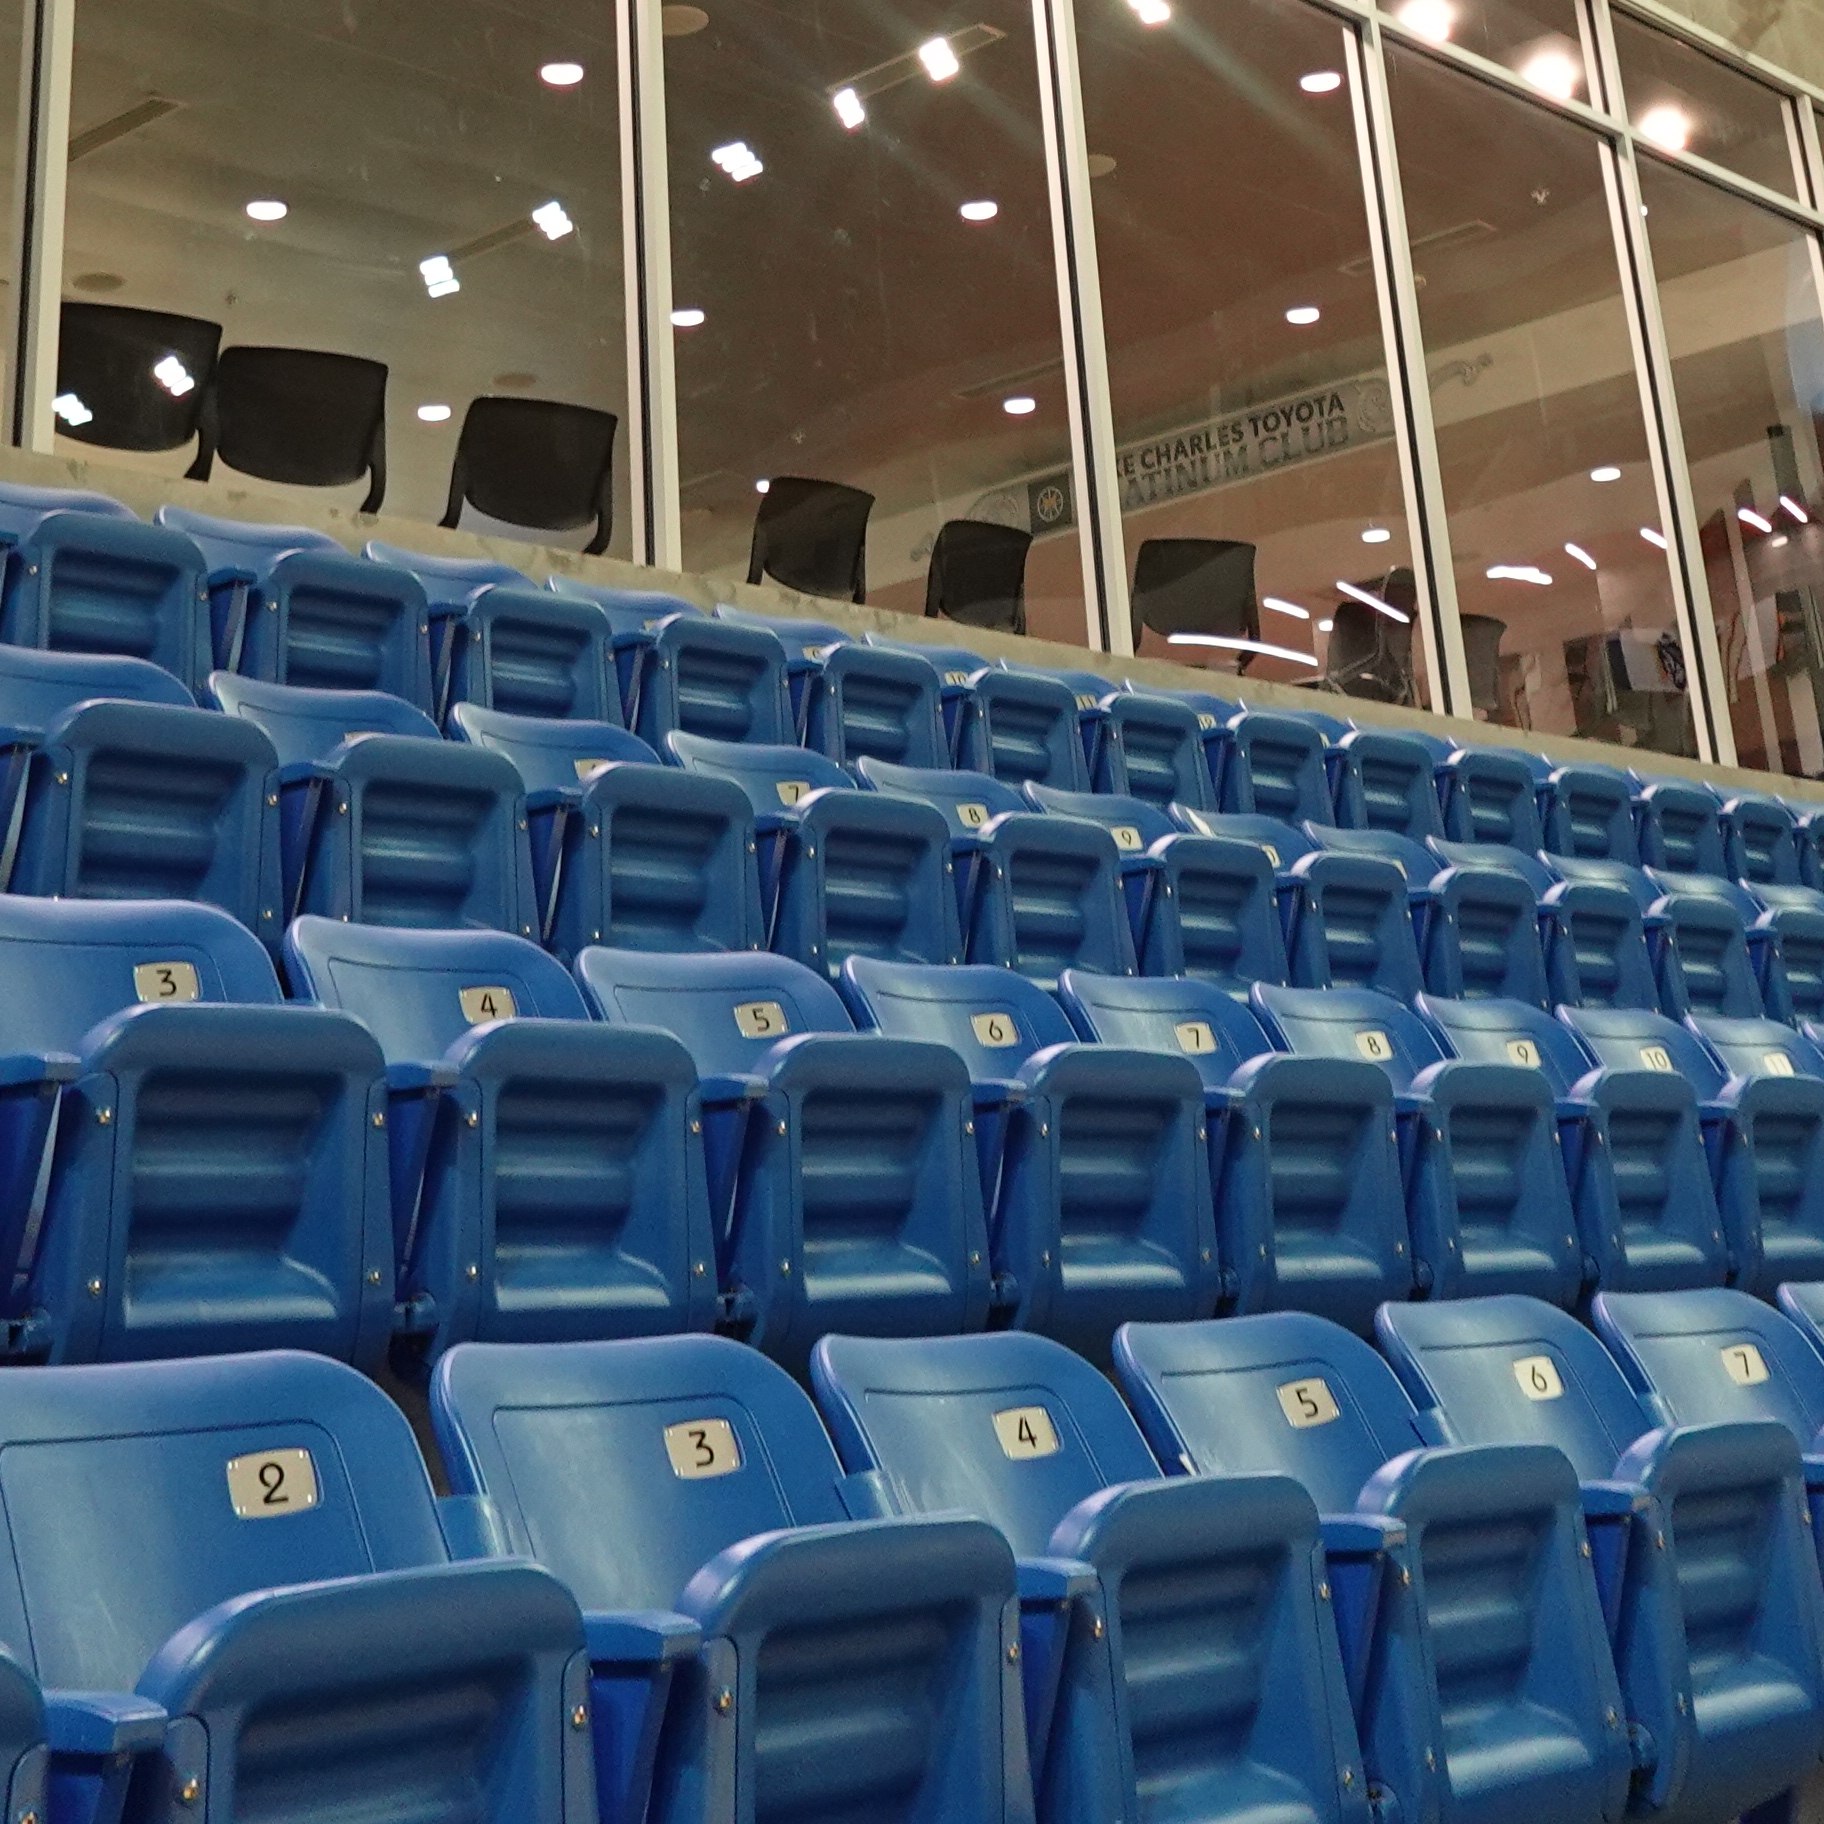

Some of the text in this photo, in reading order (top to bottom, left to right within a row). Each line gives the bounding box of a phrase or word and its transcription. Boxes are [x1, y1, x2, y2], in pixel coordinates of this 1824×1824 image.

[1140, 420, 1244, 470] CHARLES
[1248, 391, 1346, 439] TOYOTA
[788, 785, 799, 803] 7
[968, 806, 981, 824] 8
[1121, 829, 1132, 846] 9
[156, 969, 177, 996] 3
[480, 992, 498, 1017] 4
[752, 1007, 770, 1032] 5
[988, 1018, 1004, 1042] 6
[1188, 1027, 1200, 1049] 7
[1367, 1035, 1382, 1056] 8
[1516, 1044, 1529, 1064] 9
[1646, 1050, 1668, 1071] 10
[1733, 1350, 1750, 1378] 7
[1531, 1365, 1548, 1393] 6
[1295, 1387, 1318, 1418] 5
[1017, 1416, 1038, 1449] 4
[688, 1430, 714, 1467] 3
[258, 1461, 289, 1505] 2
